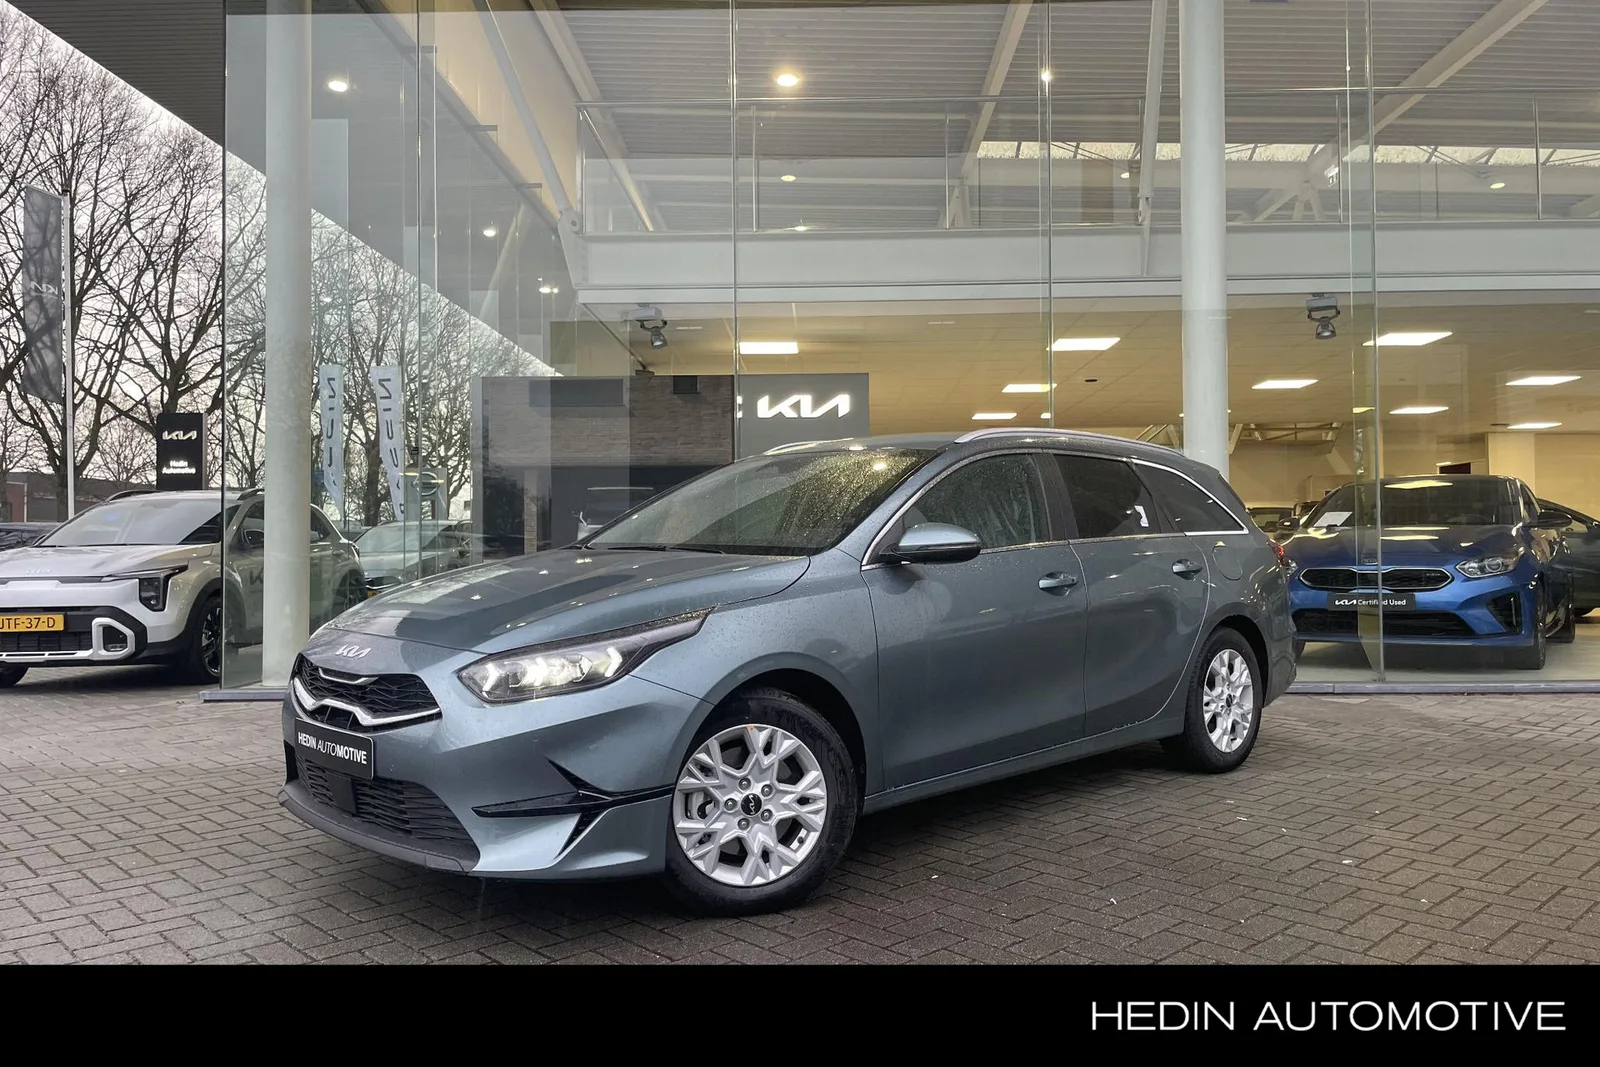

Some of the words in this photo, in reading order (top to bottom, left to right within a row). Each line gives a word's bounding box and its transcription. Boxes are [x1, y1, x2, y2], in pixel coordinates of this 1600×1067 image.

[757, 394, 851, 418] KIA
[162, 430, 197, 440] KIA
[335, 644, 372, 659] KIA
[297, 731, 317, 750] HEDIN
[317, 739, 368, 765] AUTOMOTIVE
